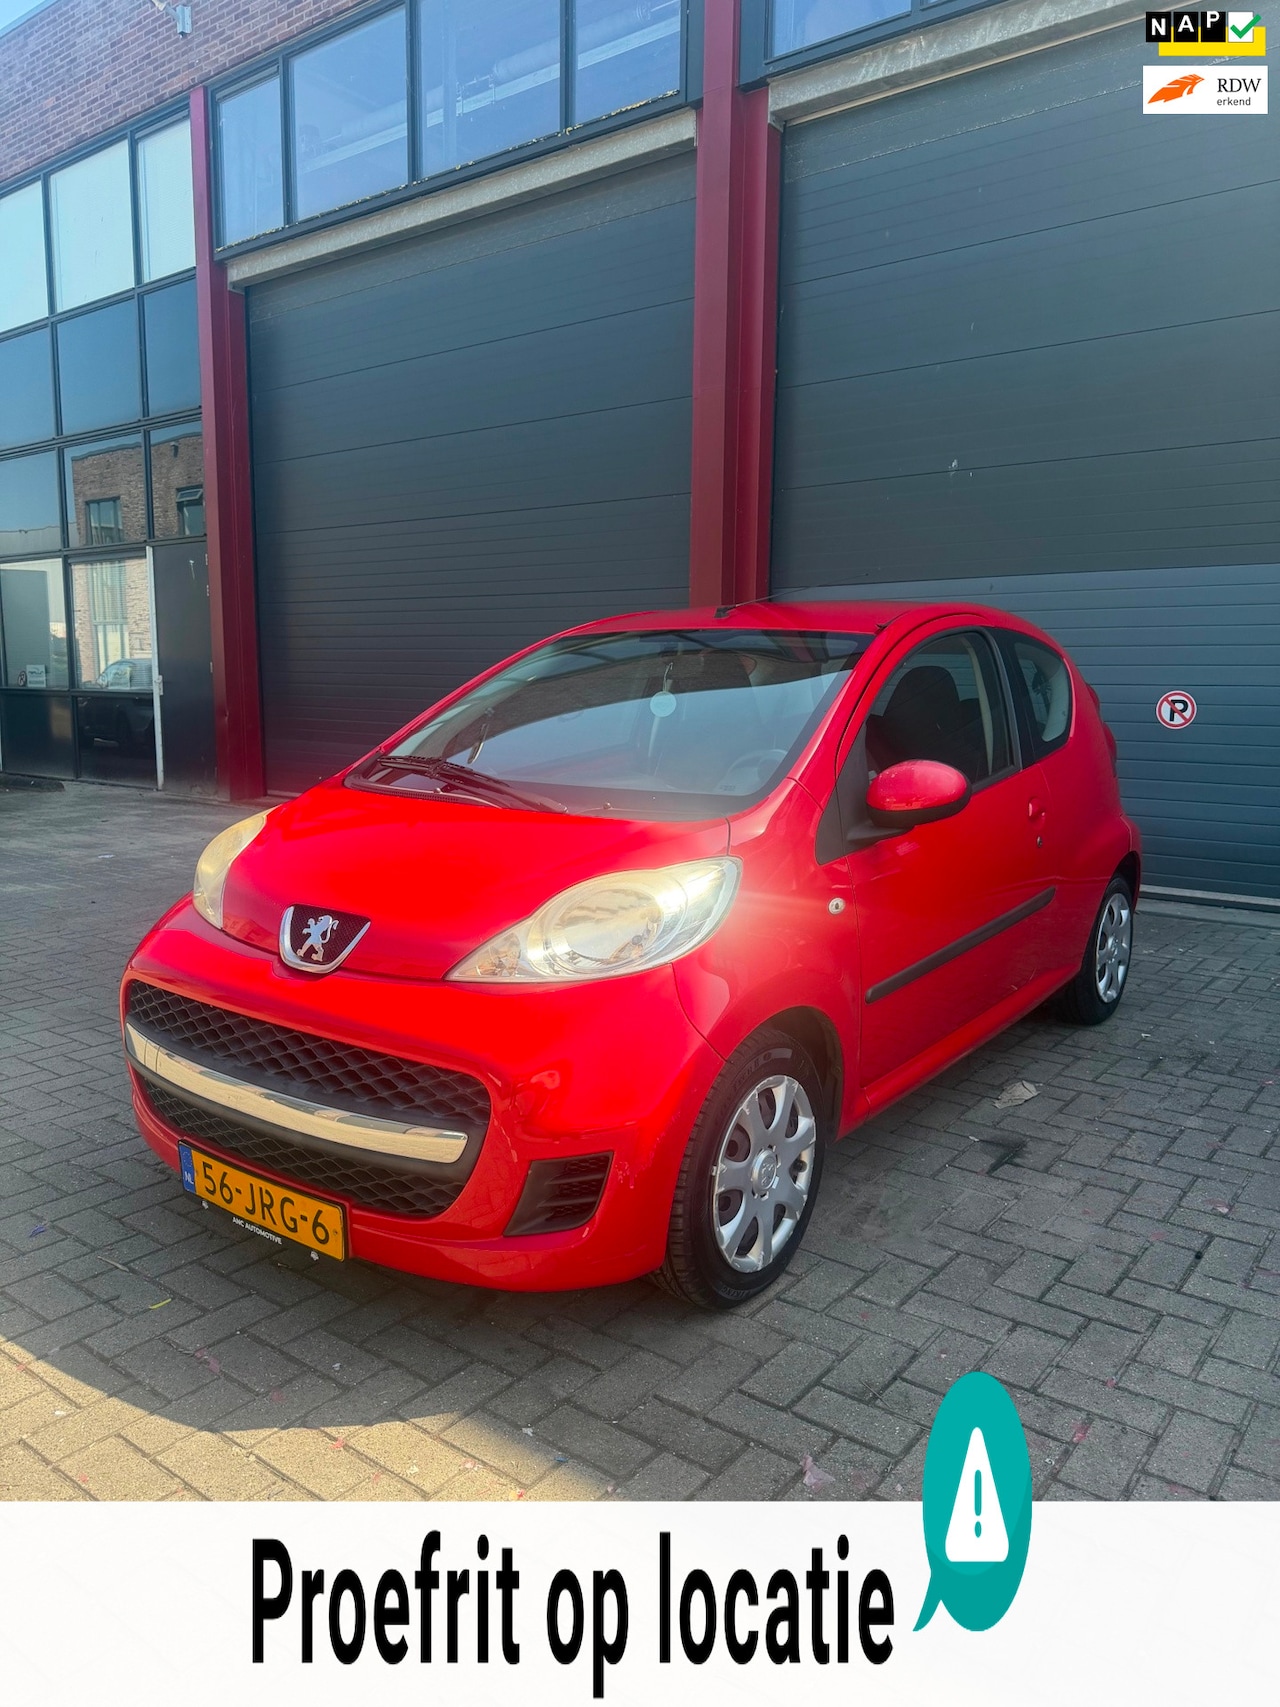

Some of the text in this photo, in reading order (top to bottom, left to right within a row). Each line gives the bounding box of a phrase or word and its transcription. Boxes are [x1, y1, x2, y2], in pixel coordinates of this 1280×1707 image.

[184, 1171, 195, 1185] NL
[202, 1161, 330, 1245] 56-JRG-6
[244, 1222, 283, 1245] AUTOMOTIVE
